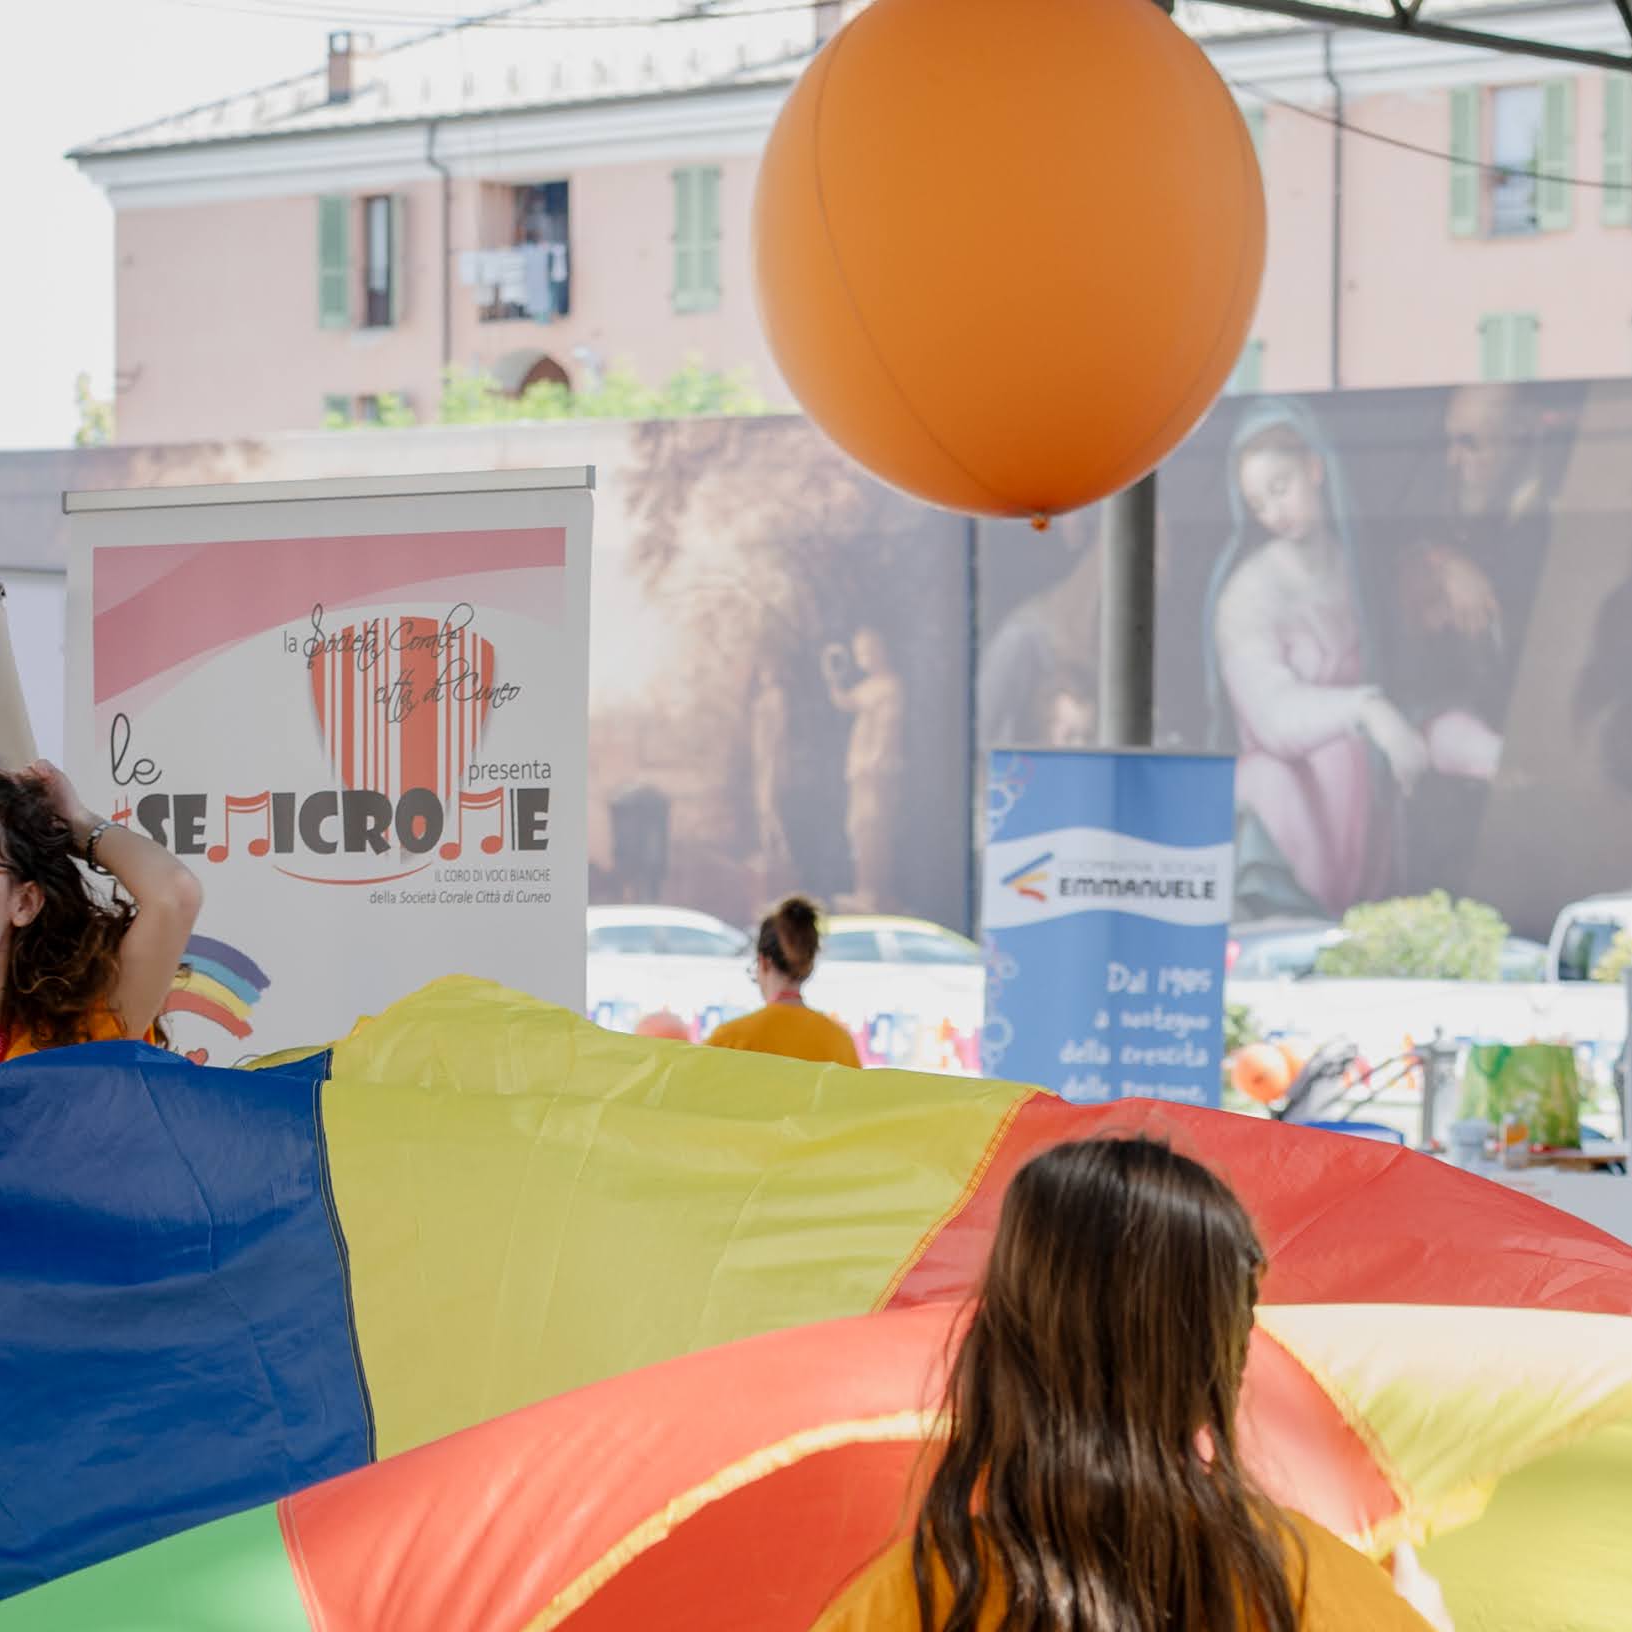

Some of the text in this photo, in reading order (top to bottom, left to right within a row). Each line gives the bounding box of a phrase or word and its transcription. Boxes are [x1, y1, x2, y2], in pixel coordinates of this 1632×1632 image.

[284, 631, 297, 653] la
[389, 602, 474, 658] Corale
[423, 657, 470, 702] di
[453, 671, 521, 708] Cuneo
[111, 713, 162, 786] le
[468, 758, 552, 783] presenta
[435, 868, 551, 882] IL CORO DI VOCI BIANCHE
[370, 890, 551, 904] della Società Corale Città di Cuneo
[1059, 876, 1215, 901] EMMANUELE
